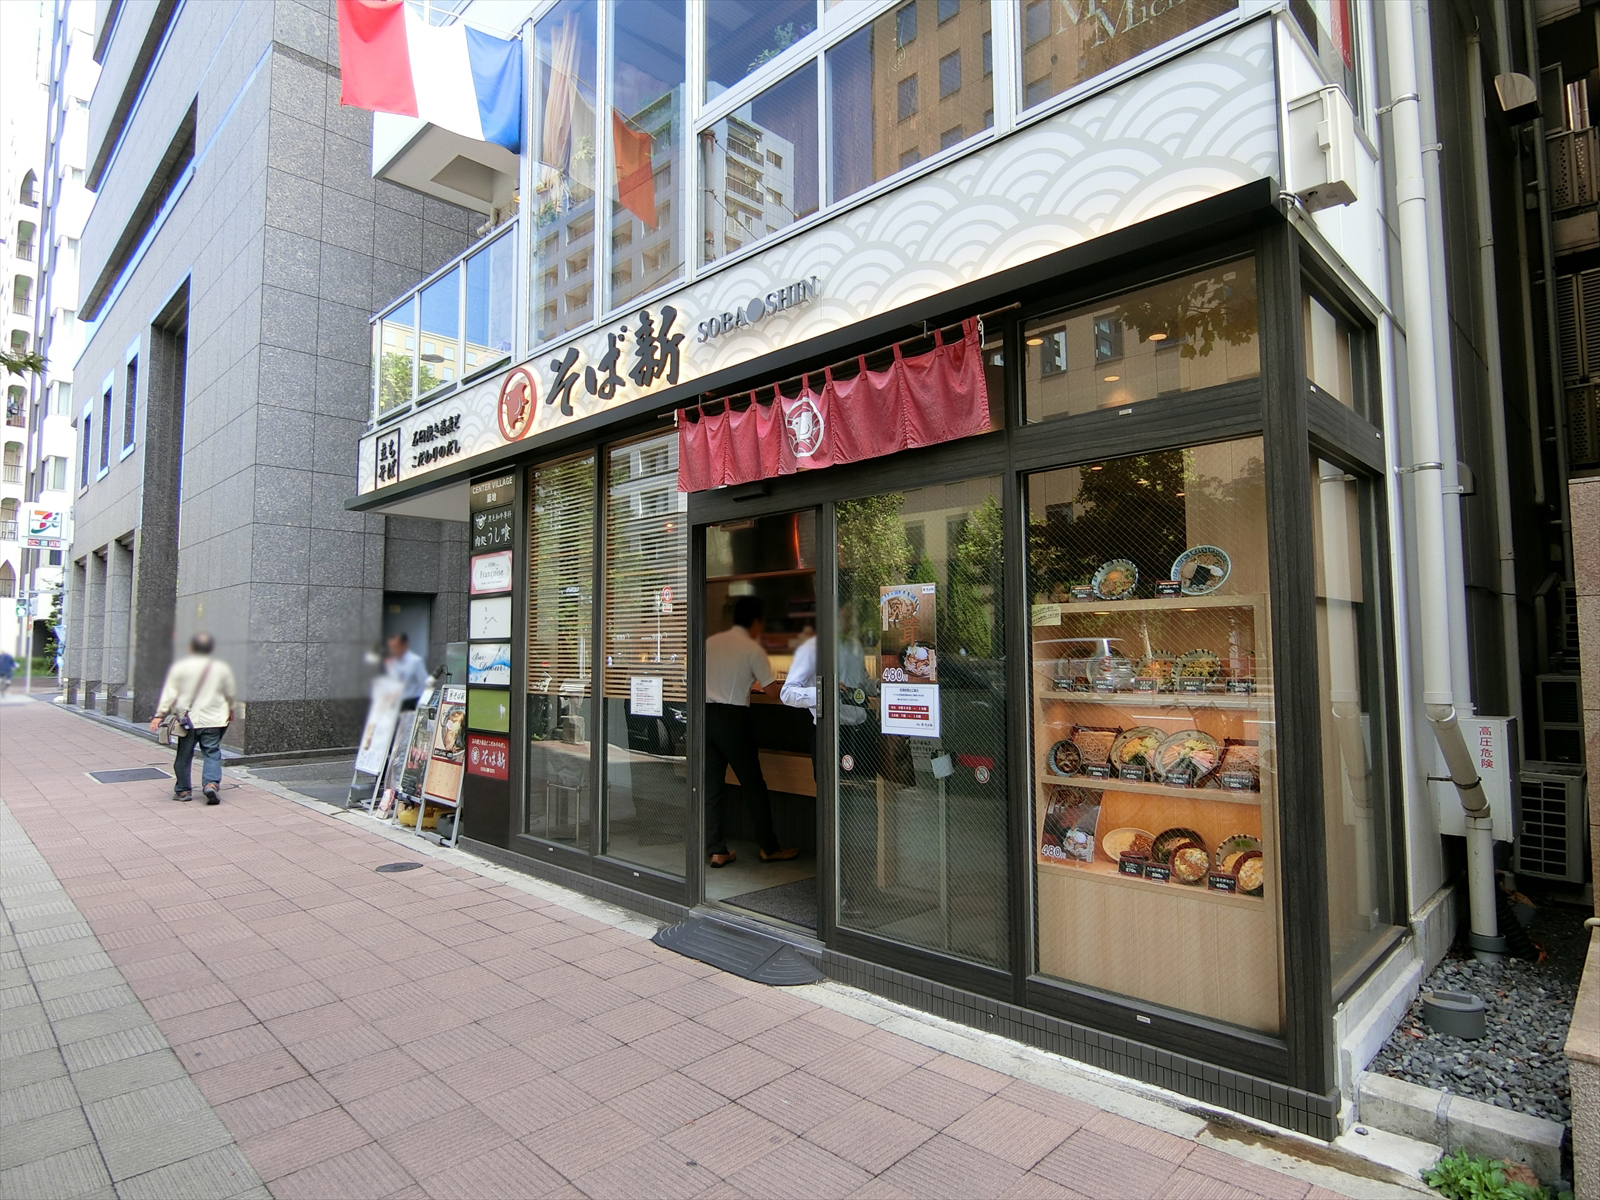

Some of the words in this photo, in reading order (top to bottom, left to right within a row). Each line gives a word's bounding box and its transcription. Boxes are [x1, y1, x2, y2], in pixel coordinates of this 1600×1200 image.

[546, 304, 686, 417] そば新
[411, 439, 461, 468] こだわりのだし
[472, 483, 492, 495] CENTER
[492, 476, 513, 489] VILLAGE
[1478, 726, 1494, 769] 高圧危険
